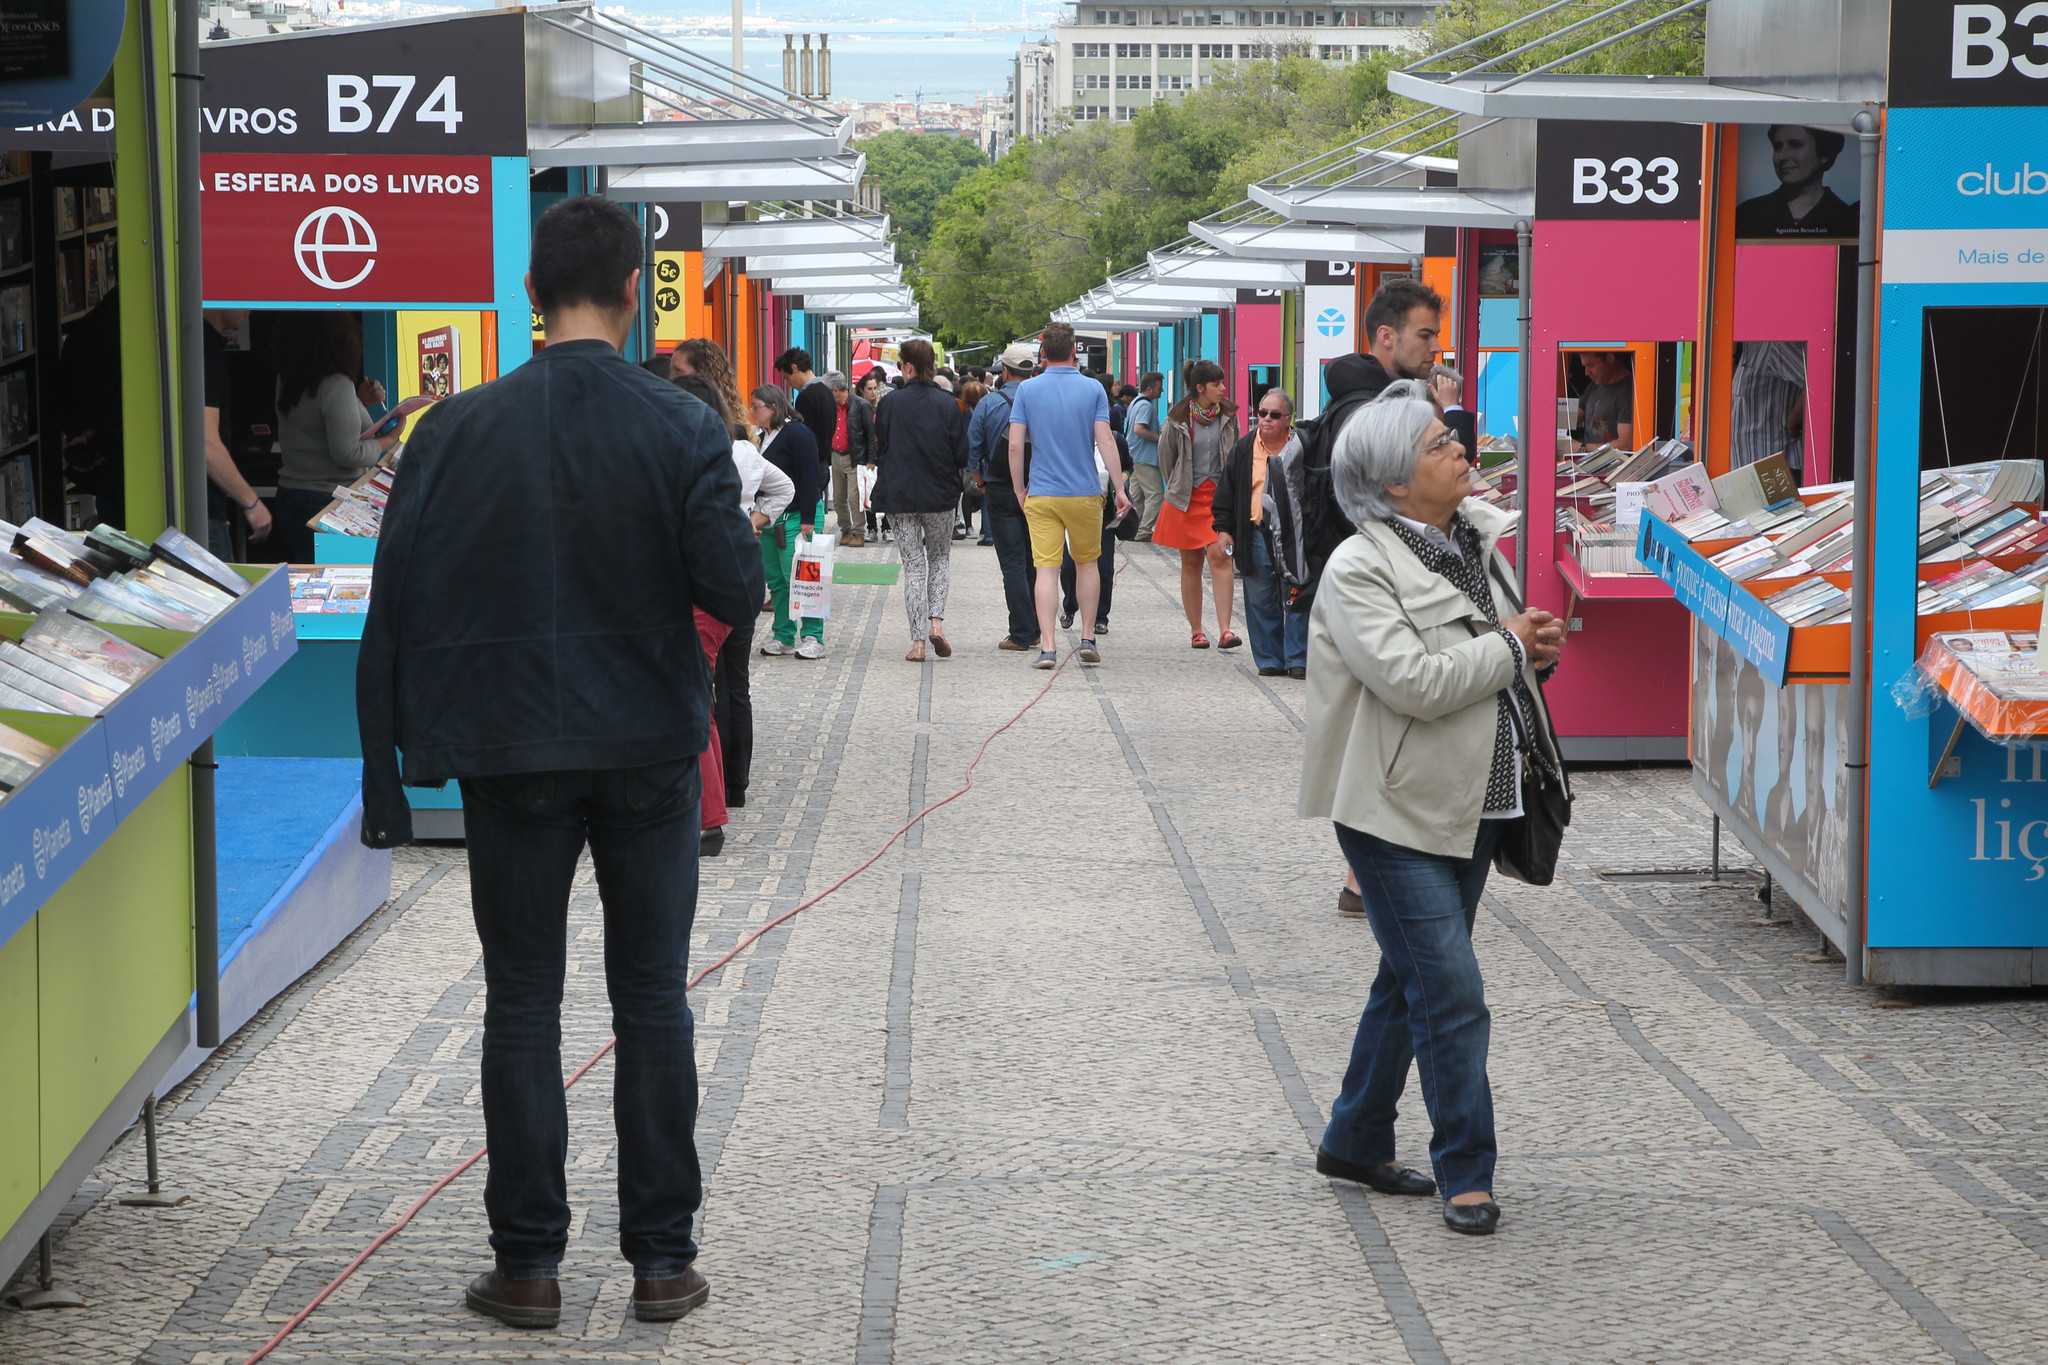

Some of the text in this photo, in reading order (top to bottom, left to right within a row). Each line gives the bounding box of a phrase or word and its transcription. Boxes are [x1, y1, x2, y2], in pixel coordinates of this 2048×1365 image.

[199, 107, 298, 134] VROS
[327, 74, 464, 134] B74
[214, 172, 480, 194] ESFERA DOS LIVROS
[1572, 157, 1680, 204] B33
[1956, 162, 2048, 196] club
[660, 263, 677, 279] 5€
[1958, 248, 2045, 265] Mais de
[1674, 560, 1700, 605] porque
[1702, 578, 1728, 622] preciso
[1748, 609, 1776, 665] página
[249, 634, 268, 664] Planeta
[219, 659, 239, 692] Planeta
[193, 683, 215, 717] Planeta
[159, 711, 181, 749] Planeta
[122, 744, 146, 784] Planeta
[87, 778, 113, 820] Planeta
[43, 818, 71, 863] Planeta
